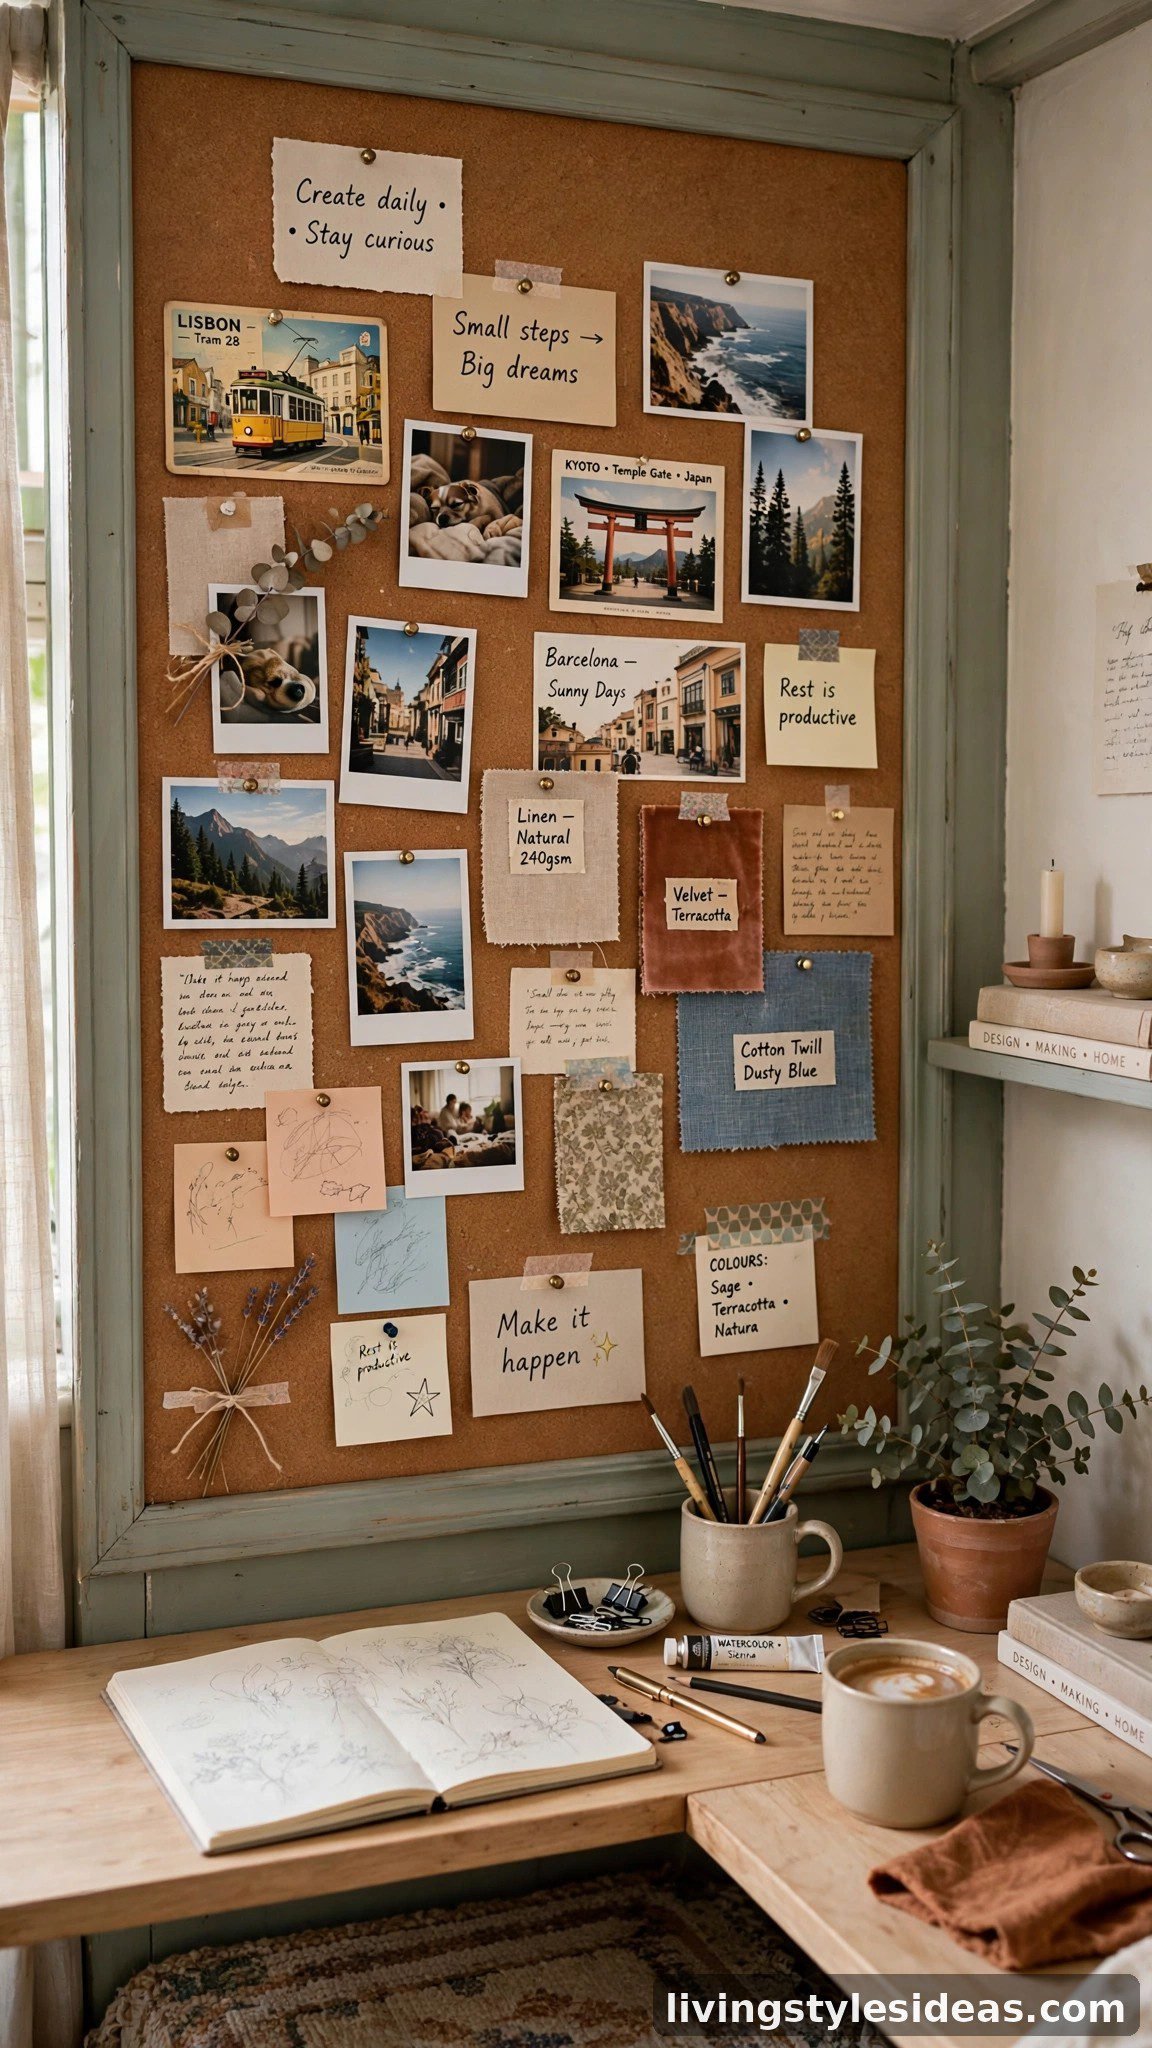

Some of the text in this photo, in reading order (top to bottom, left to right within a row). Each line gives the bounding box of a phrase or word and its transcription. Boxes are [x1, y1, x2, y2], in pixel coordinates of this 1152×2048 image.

[296, 178, 427, 224] Create daily
[305, 220, 434, 259] Stay curious
[177, 314, 241, 333] LISBON
[453, 310, 570, 351] Small steps
[194, 333, 240, 347] Tram 28
[461, 350, 578, 388] Big dreams
[565, 459, 712, 486] KYOTO Temple Gate Japan
[545, 646, 619, 669] Barcelona
[547, 678, 626, 706] Sunny Days
[780, 678, 835, 698] Rest is
[779, 706, 857, 731] productive
[517, 807, 557, 823] Linen
[517, 828, 570, 845] Natural
[520, 850, 572, 871] 240gsm
[673, 886, 713, 902] Velvet
[672, 907, 732, 922] Terracotta
[741, 1037, 822, 1058] Cotton Twill
[983, 1031, 1126, 1068] DESIGN MAKING HOME
[744, 1062, 818, 1084] Dusty Blue
[710, 1253, 768, 1272] COLOURS:
[711, 1280, 741, 1298] Sage
[712, 1298, 776, 1316] Terracotta
[497, 1305, 590, 1339] Make it
[715, 1322, 759, 1338] Natura
[359, 1341, 381, 1359] Rest
[357, 1352, 411, 1382] productive
[502, 1347, 580, 1381] happen
[718, 1638, 774, 1649] WATERCOLOR
[1013, 1651, 1145, 1744] DESIGN MAKING HOME
